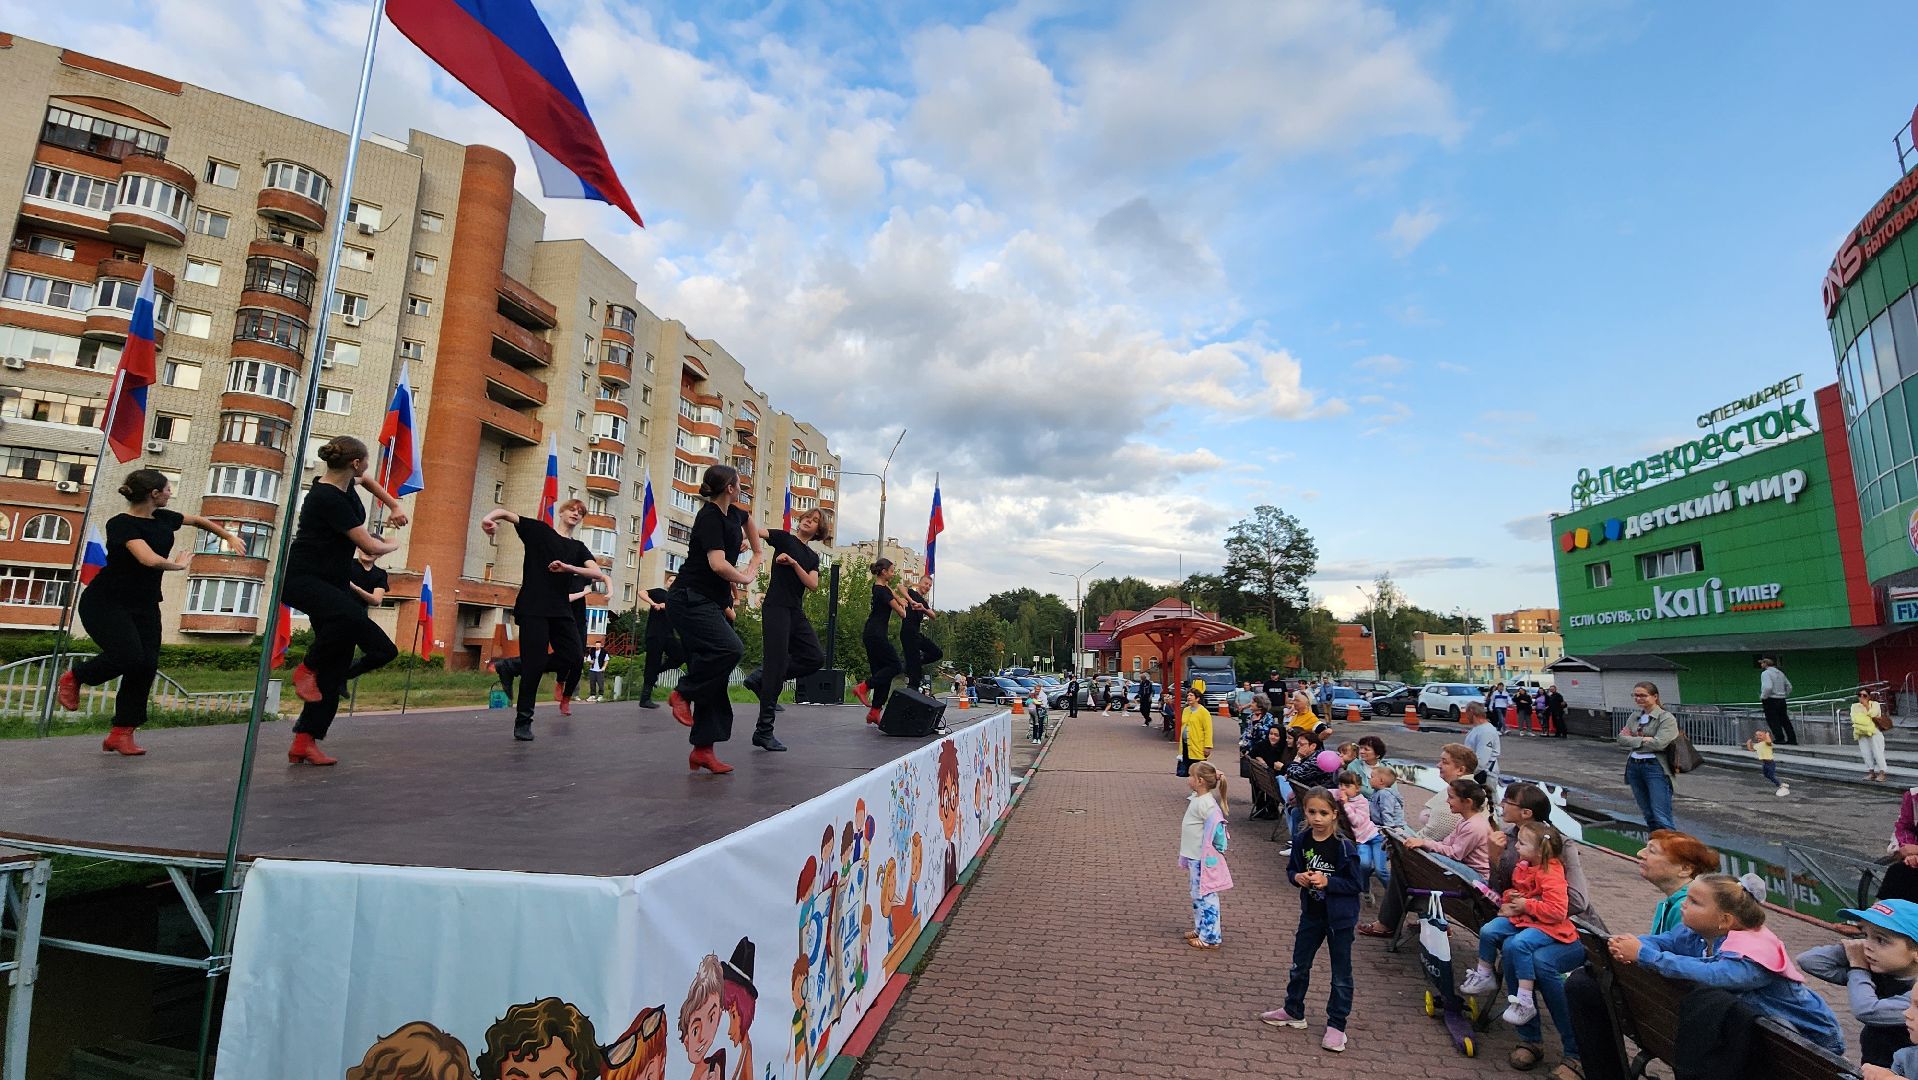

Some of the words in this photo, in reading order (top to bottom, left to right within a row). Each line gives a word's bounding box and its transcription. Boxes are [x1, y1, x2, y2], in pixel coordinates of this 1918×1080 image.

[1821, 232, 1862, 319] DNS
[1697, 373, 1804, 428] СУПЕРМАРКЕТ
[1625, 480, 1734, 539] детский
[1737, 469, 1807, 504] мир
[1569, 614, 1595, 627] ЕСЛИ
[1597, 610, 1635, 624] ОБУВЬ,
[1635, 608, 1652, 620] ТО
[1653, 577, 1724, 619] kari
[1728, 583, 1782, 604] ГИПЕР
